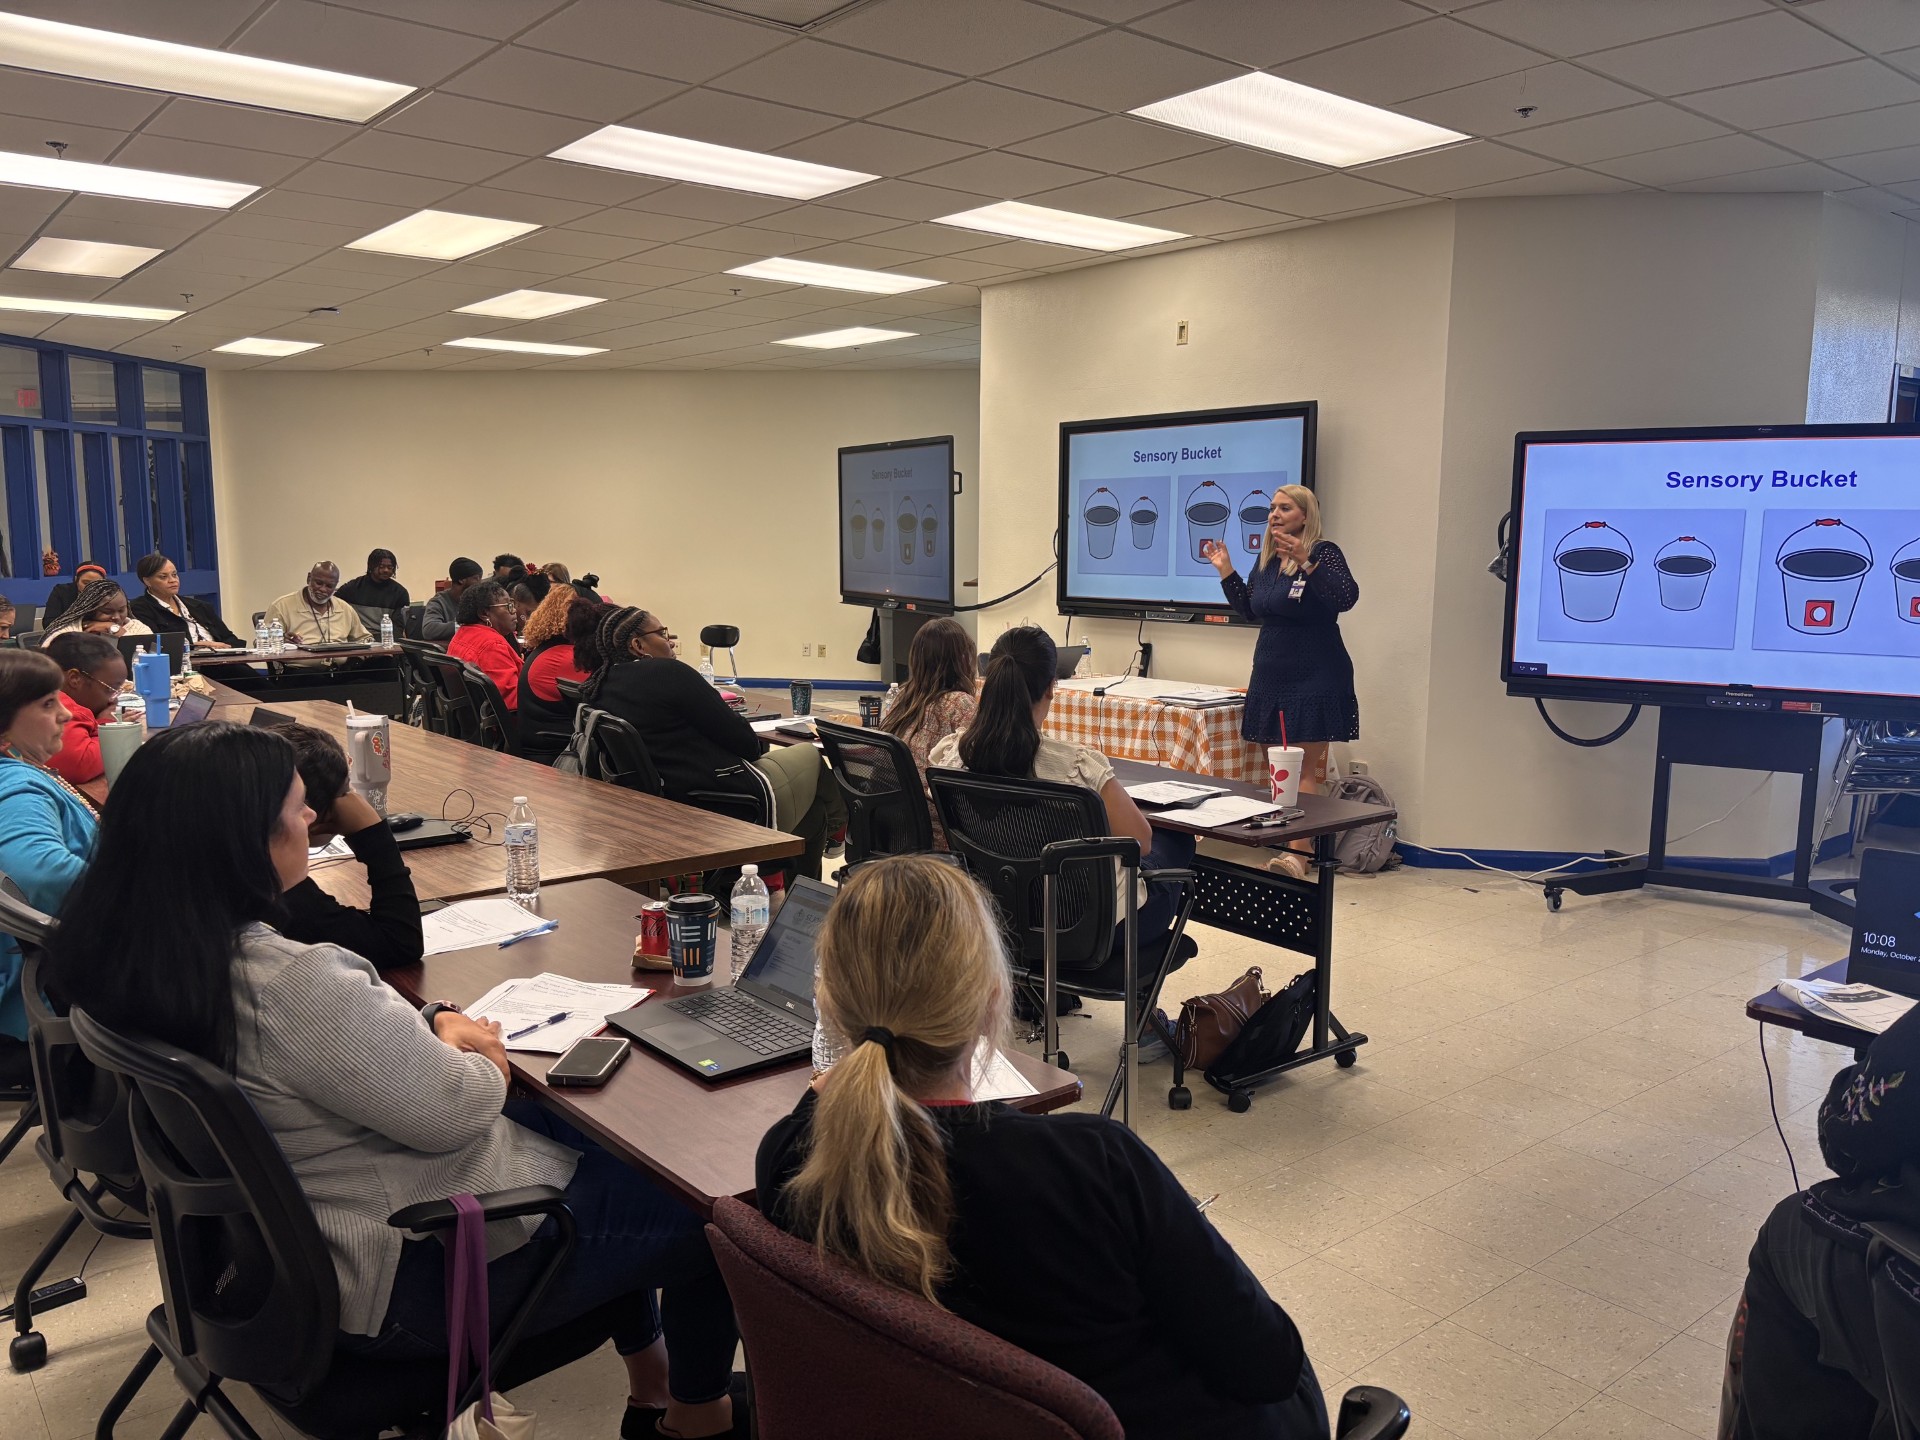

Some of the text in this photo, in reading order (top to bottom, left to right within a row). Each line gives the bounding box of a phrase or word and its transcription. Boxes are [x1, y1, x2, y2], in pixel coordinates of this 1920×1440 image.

[1133, 446, 1222, 464] Sensory Bucket
[871, 467, 912, 481] Sensory Bucket
[1666, 470, 1858, 492] Sensory Bucket
[1863, 932, 1896, 947] 10:08
[1861, 947, 1888, 957] Monday,
[1890, 952, 1917, 961] October
